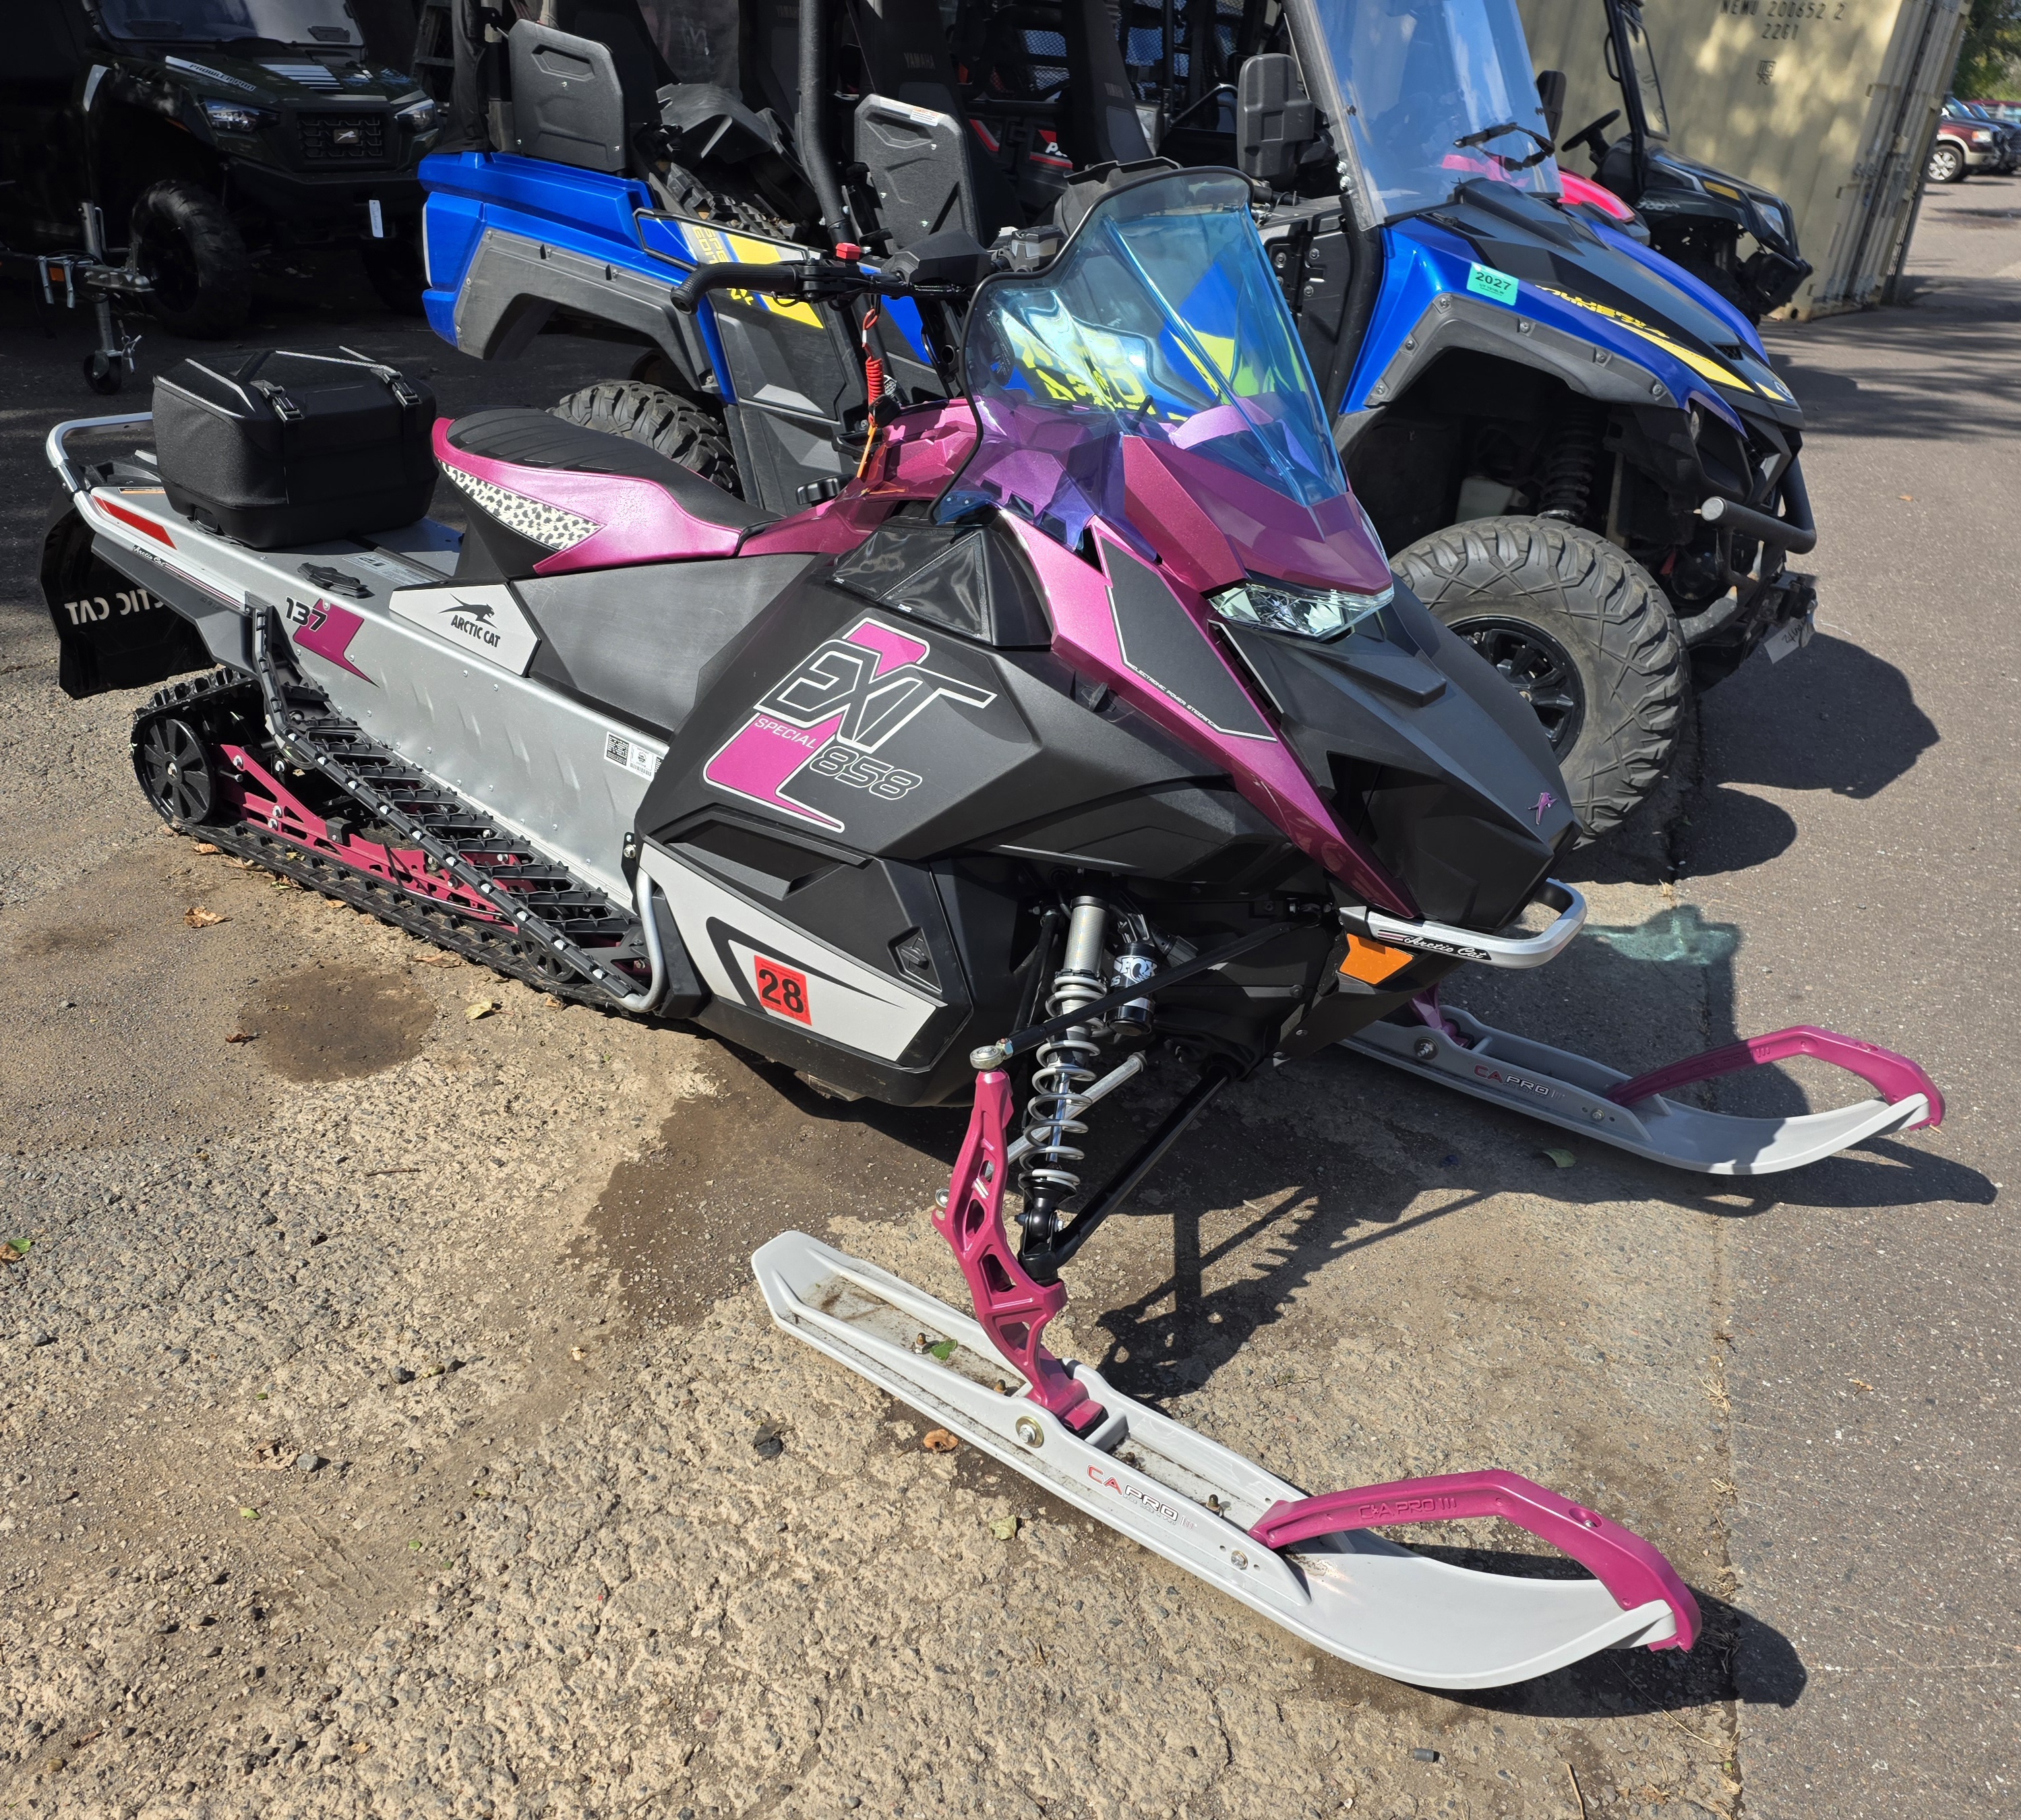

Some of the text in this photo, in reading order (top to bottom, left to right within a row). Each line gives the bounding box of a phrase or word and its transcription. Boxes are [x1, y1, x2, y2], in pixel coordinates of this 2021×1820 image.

[1767, 1, 1826, 19] 200652
[1833, 2, 1845, 20] 2
[903, 53, 936, 69] YAMAHA
[189, 64, 255, 90] PROWLER PRO
[1475, 272, 1511, 291] 2027
[133, 546, 166, 566] Arctic Cat
[285, 597, 328, 632] 137
[450, 614, 501, 648] ARCTIC CAT
[753, 638, 998, 754] EXT
[1130, 665, 1167, 691] ELECTRONIC
[1166, 690, 1186, 706] POWER
[754, 717, 816, 750] SPECIAL
[809, 746, 923, 800] 858
[1403, 936, 1487, 959] Arctic Cat
[1120, 957, 1157, 982] FOX
[758, 969, 804, 1014] 28
[1505, 1074, 1550, 1096] PRO
[1124, 1484, 1179, 1522] PRO
[1395, 1498, 1436, 1515] PRO
